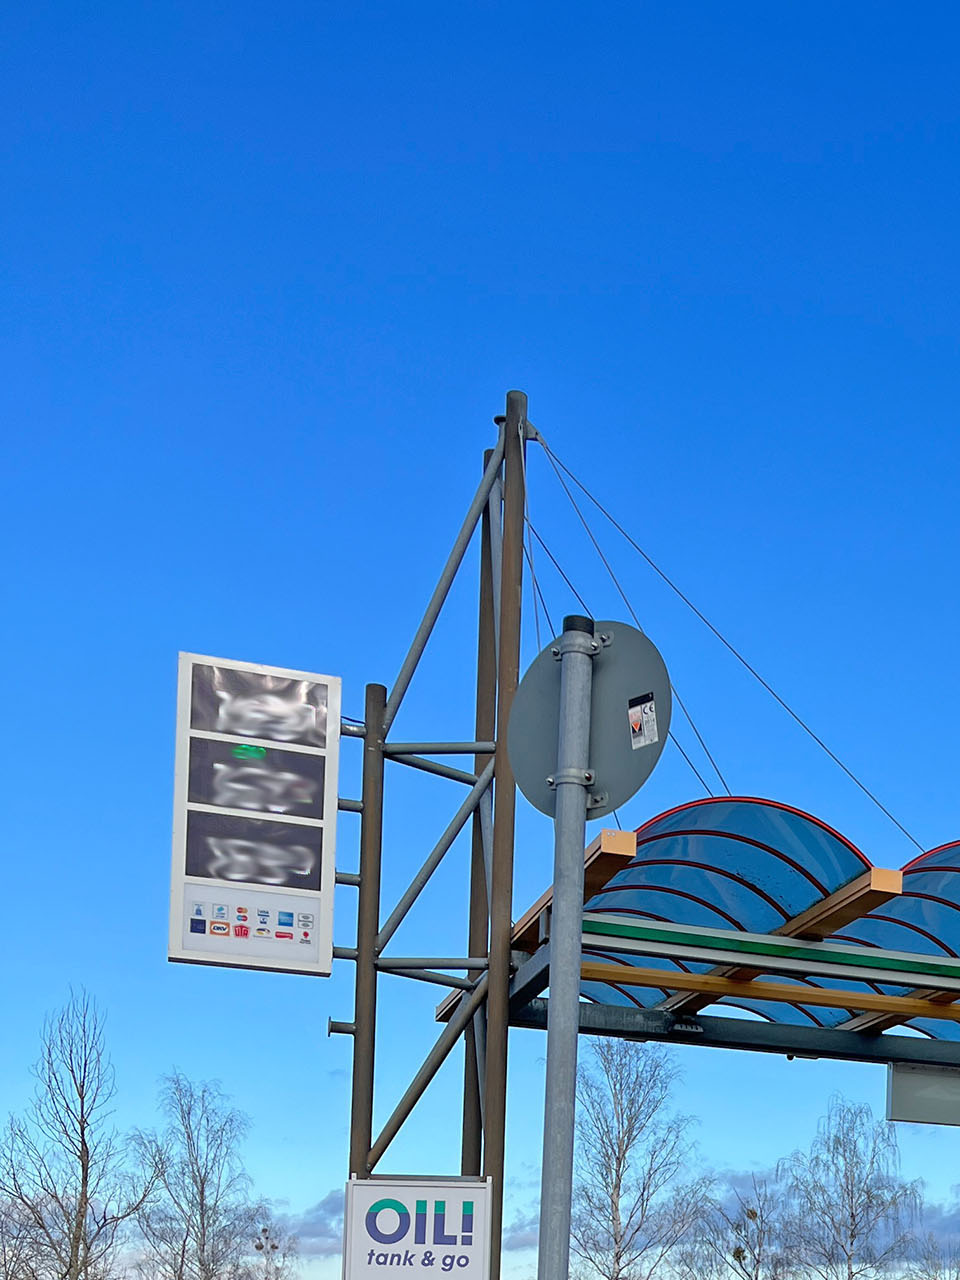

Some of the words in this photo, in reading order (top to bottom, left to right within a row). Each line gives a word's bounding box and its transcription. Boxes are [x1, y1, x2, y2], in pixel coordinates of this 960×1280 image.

[365, 1198, 474, 1246] OIL!
[367, 1249, 415, 1267] tank
[421, 1250, 435, 1266] &
[441, 1254, 469, 1272] go
